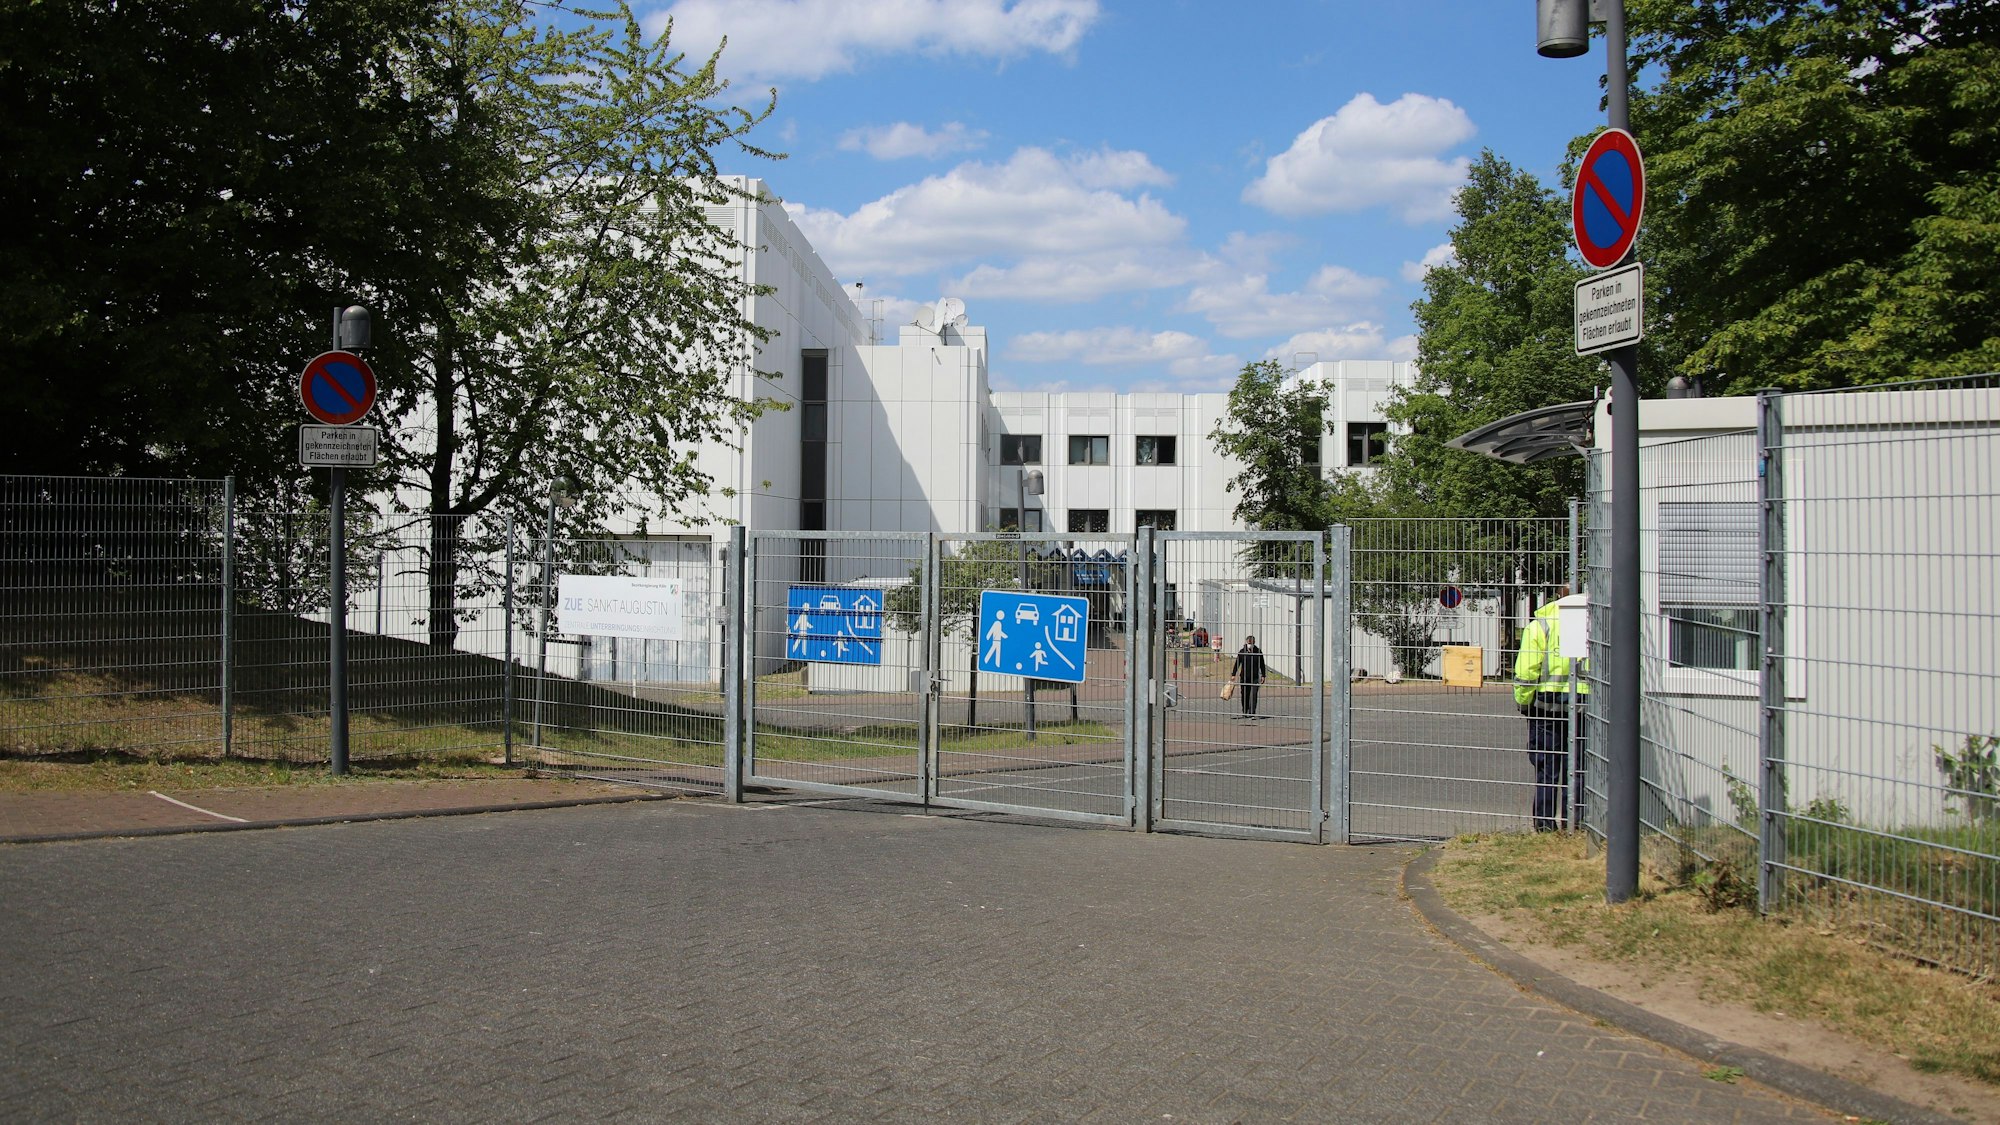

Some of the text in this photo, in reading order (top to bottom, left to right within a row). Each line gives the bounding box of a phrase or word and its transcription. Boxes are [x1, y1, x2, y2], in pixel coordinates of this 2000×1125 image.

[1591, 281, 1622, 300] Parken in
[1579, 298, 1636, 326] gekennzeichneten
[1582, 317, 1632, 340] Flächen erlaubt
[321, 431, 356, 440] Parken in
[305, 441, 372, 451] gekennzeichneten
[309, 451, 367, 461] Flächen erlaubt
[564, 598, 583, 612] ZUE
[587, 598, 618, 613] SANKT
[619, 600, 668, 616] AUGUSTIN
